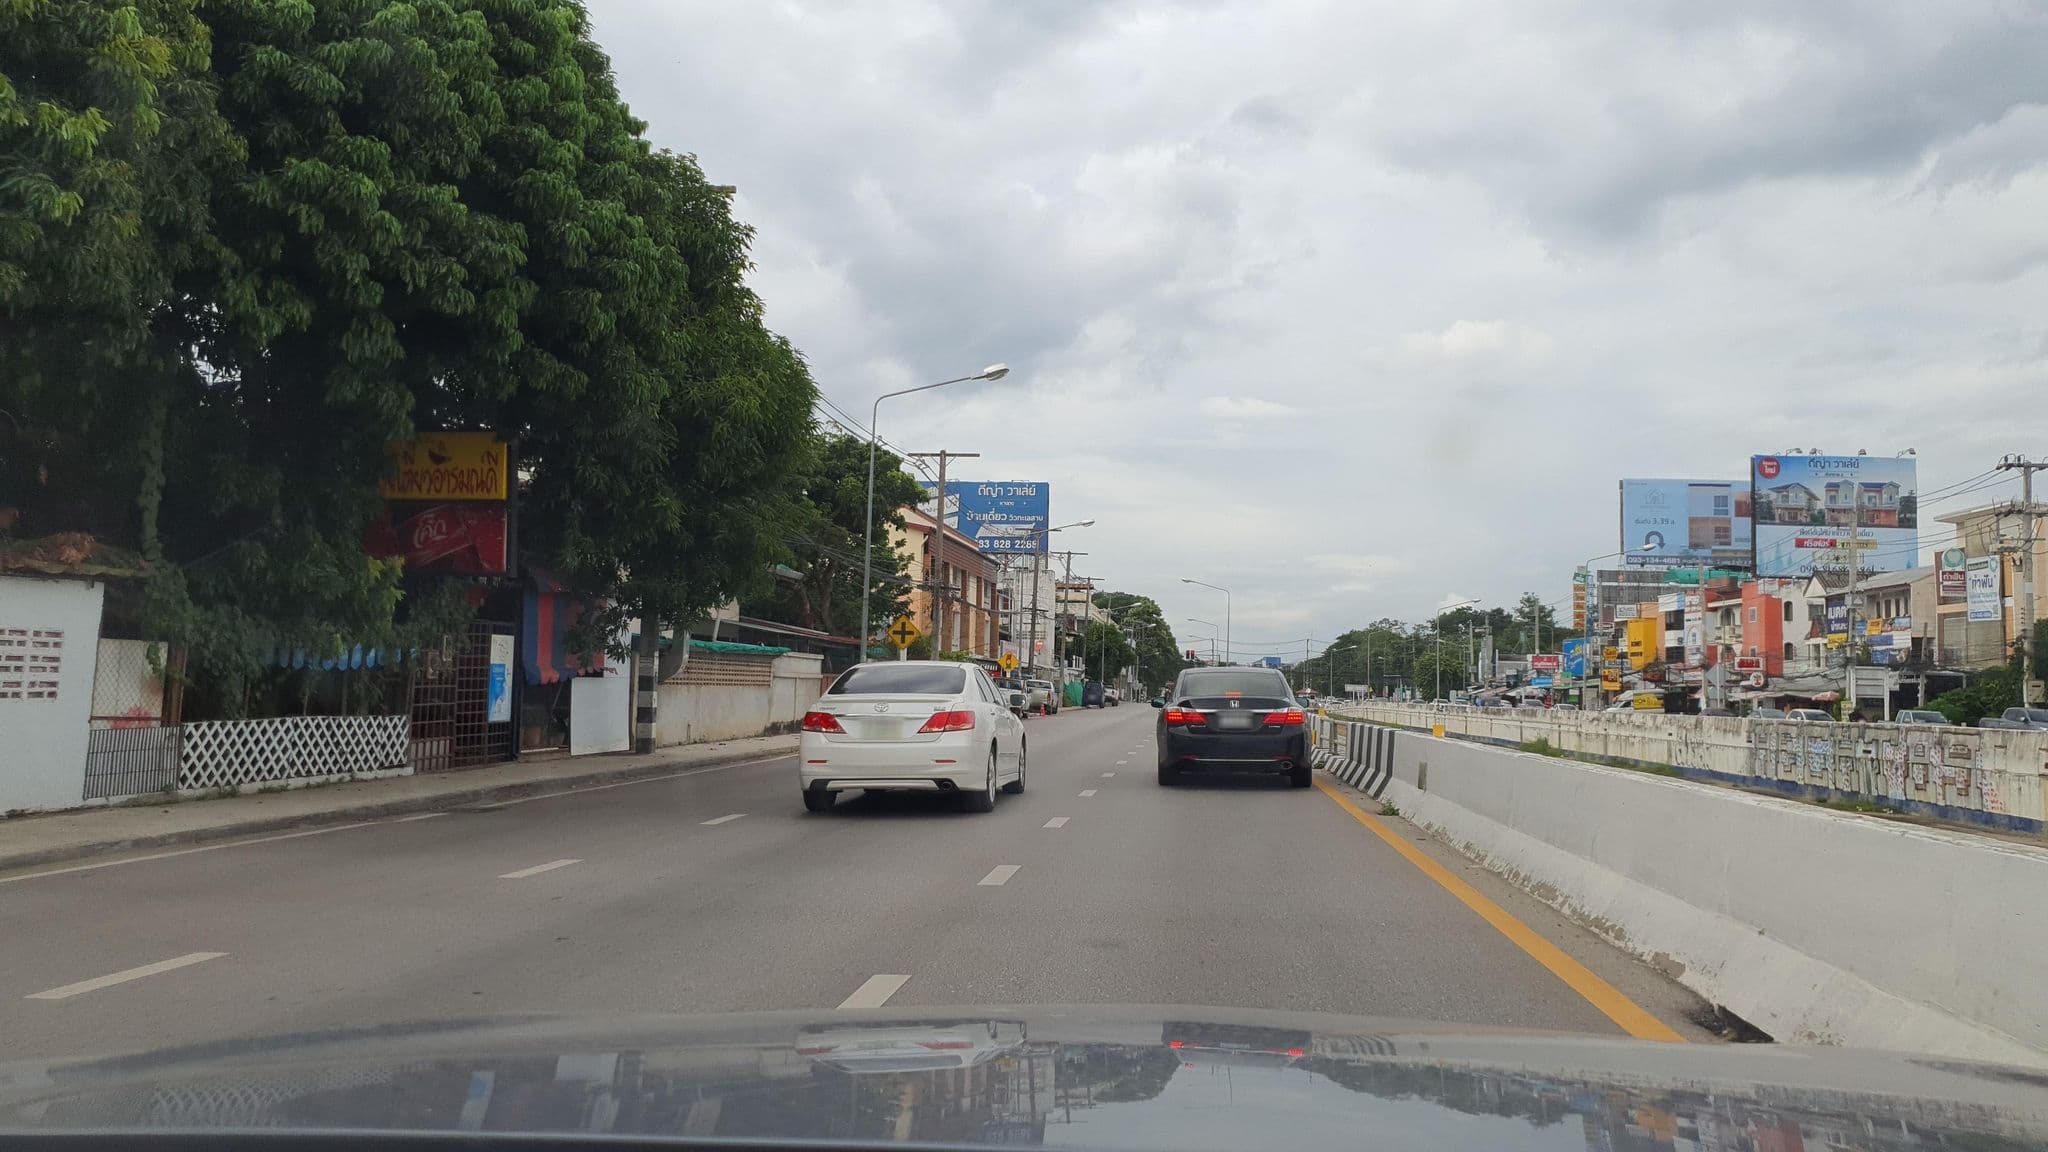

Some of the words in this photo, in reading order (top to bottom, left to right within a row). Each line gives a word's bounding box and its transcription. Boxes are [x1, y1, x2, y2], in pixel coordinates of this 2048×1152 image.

[978, 485, 1003, 497] ดีญ่า
[966, 507, 1007, 521] บ้านเดี่ยว
[994, 540, 1011, 549] 828
